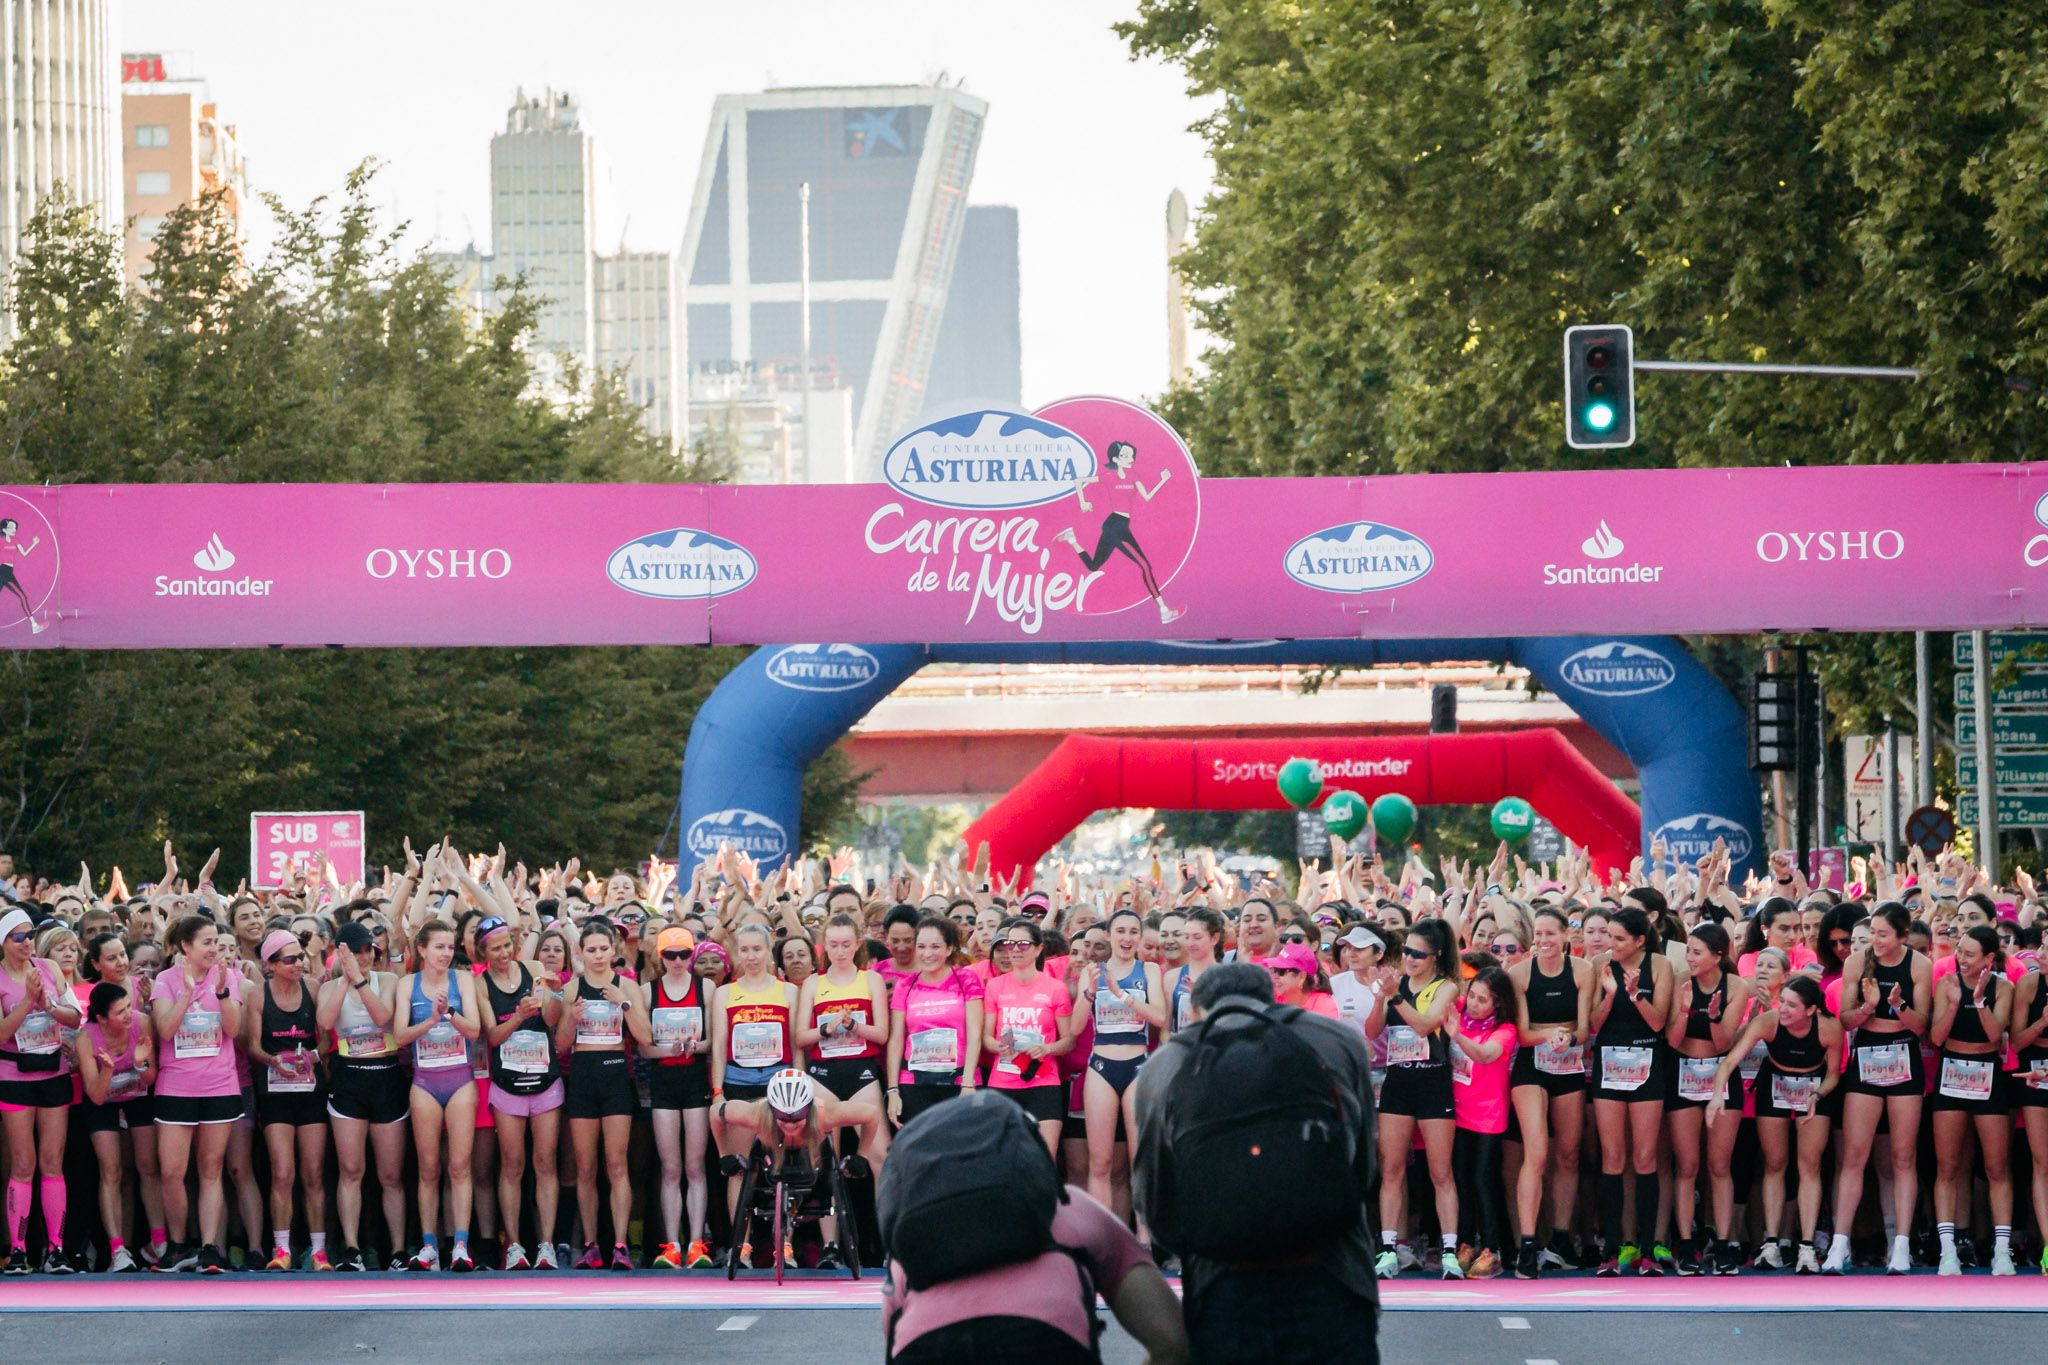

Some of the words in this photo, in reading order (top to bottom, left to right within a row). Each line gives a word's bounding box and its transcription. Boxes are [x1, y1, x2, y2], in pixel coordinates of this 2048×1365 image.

[932, 444, 998, 454] CENTRAL
[1005, 443, 1072, 453] LECHERA
[901, 447, 1079, 484] ASTURIANA
[864, 503, 1040, 554] Carrera
[1756, 529, 1905, 562] OYSHO
[365, 548, 512, 579] OYSHO
[618, 554, 746, 581] ASTURIANA
[1296, 549, 1422, 575] ASTURIANA
[1543, 563, 1664, 585] Santander
[155, 575, 274, 596] Santander
[907, 556, 940, 592] de
[946, 554, 970, 592] la
[965, 547, 1105, 634] Mujer
[774, 656, 871, 679] ASTURIANA
[1570, 662, 1668, 683] ASTURIANA
[1992, 731, 2037, 742] abana
[1213, 759, 1277, 783] Sports
[270, 822, 318, 844] SUB
[695, 828, 780, 852] ASTRIANA
[1002, 1007, 1042, 1024] HOY
